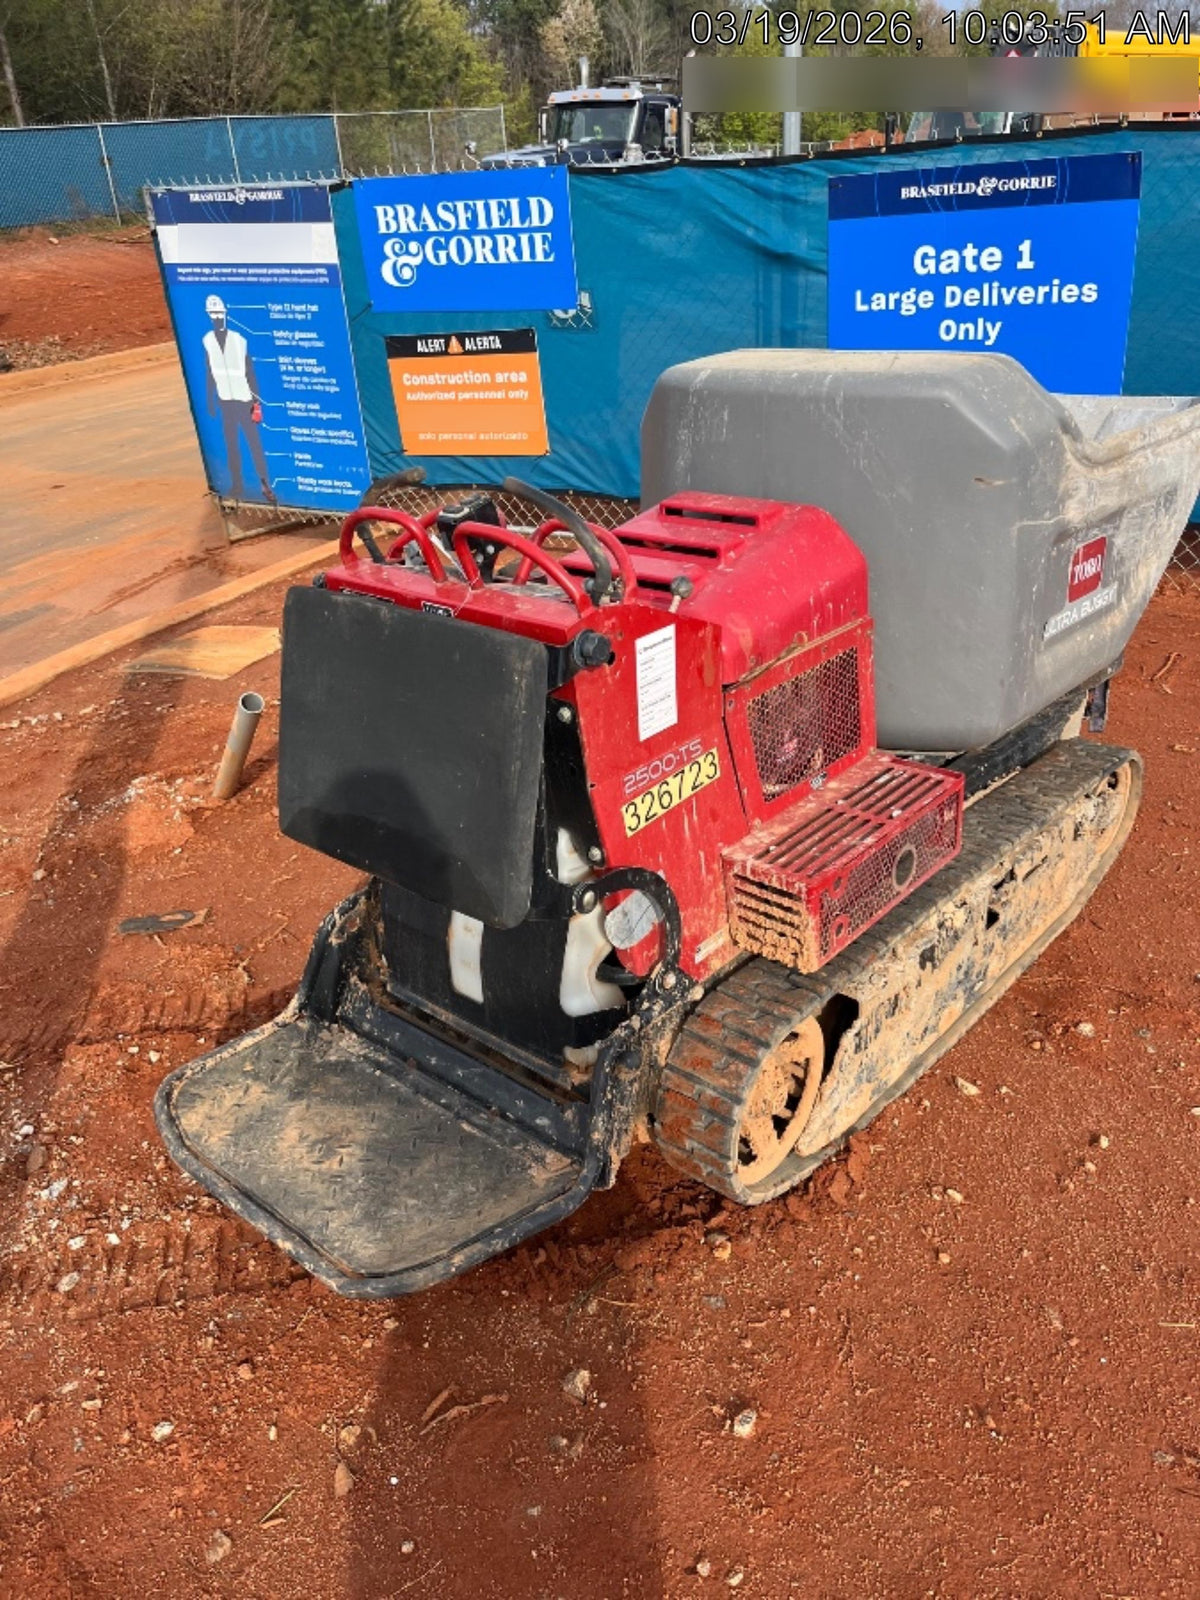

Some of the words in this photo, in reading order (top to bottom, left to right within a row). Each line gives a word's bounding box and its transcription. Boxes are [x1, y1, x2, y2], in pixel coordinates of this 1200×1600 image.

[374, 196, 554, 234] BRASFIELD
[913, 243, 1003, 275] Gate
[1016, 239, 1035, 270] 1
[855, 288, 934, 316] Large
[945, 278, 1098, 308] Deliveries
[417, 338, 446, 353] ALERT
[465, 335, 502, 351] ALERTA
[939, 317, 1002, 345] Only
[402, 370, 492, 386] Construction
[495, 370, 528, 384] area
[406, 390, 456, 402] Authorized
[458, 389, 505, 402] personnel
[508, 389, 529, 401] only
[625, 751, 718, 832] 326723
